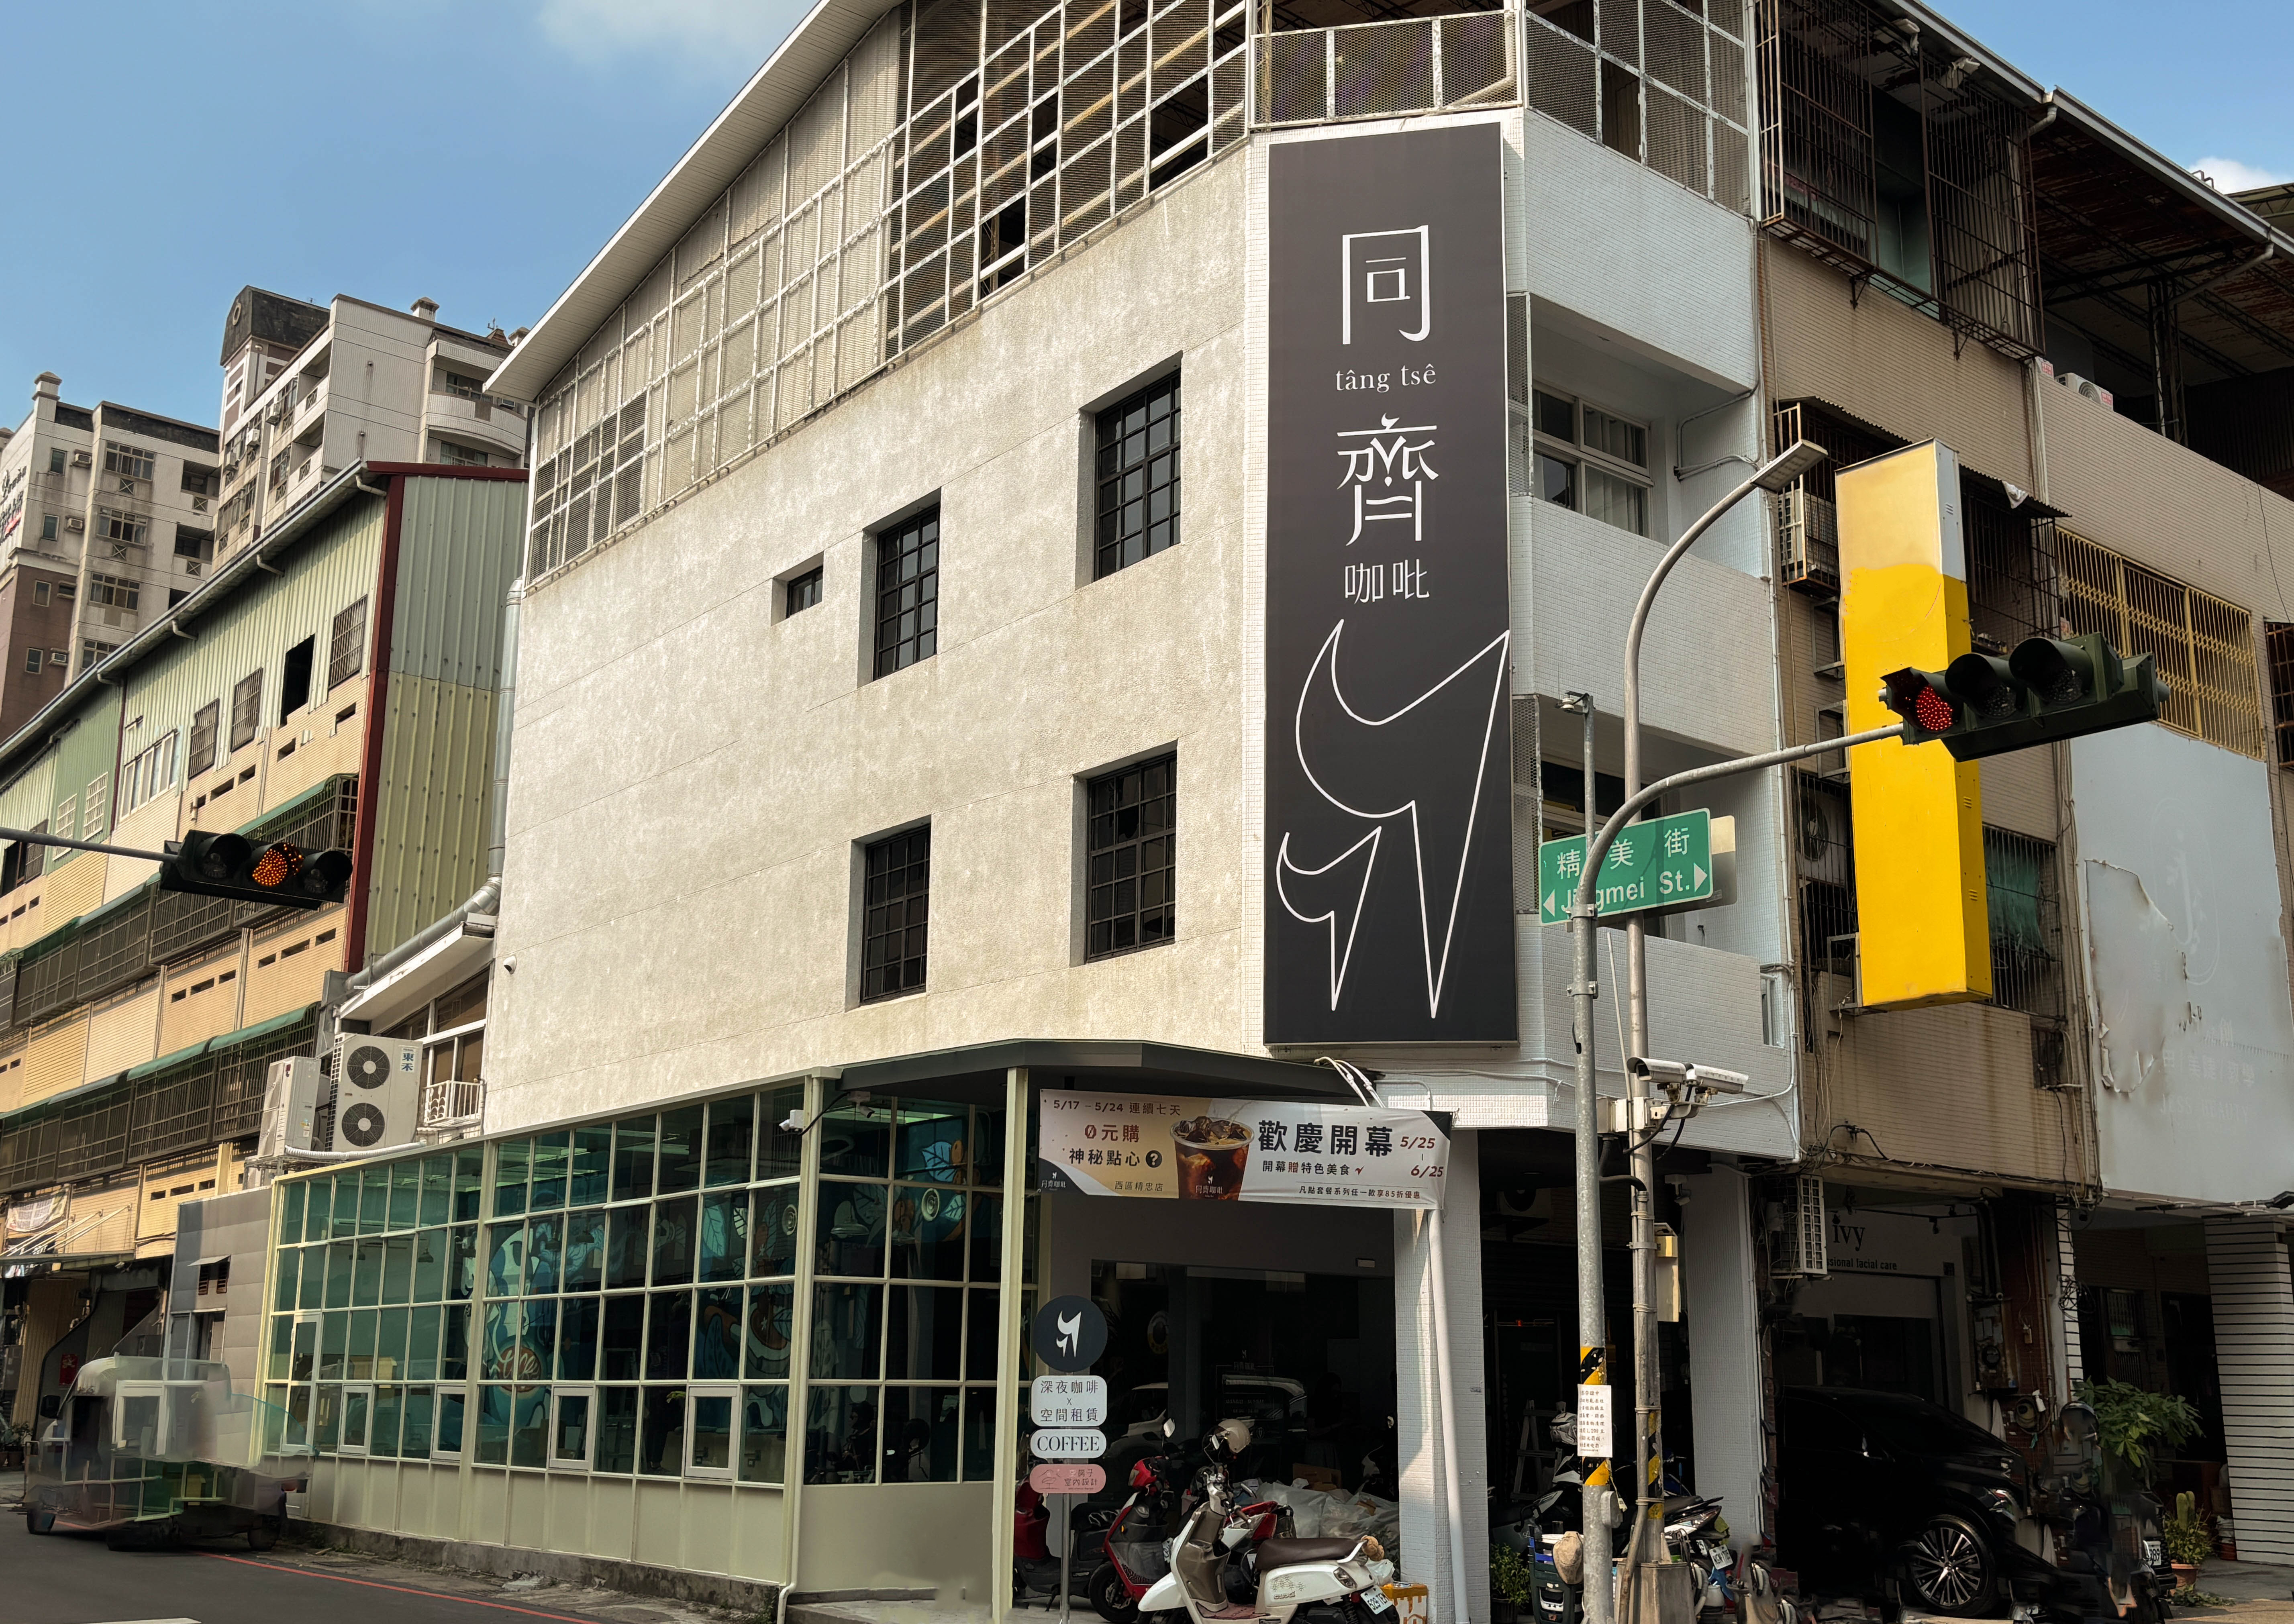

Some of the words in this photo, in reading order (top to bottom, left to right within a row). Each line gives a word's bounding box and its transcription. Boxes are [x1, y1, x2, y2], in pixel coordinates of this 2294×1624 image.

[1335, 368, 1391, 393] tâng
[1401, 363, 1436, 386] tsê
[1557, 827, 1690, 879] 精美街
[1561, 876, 1645, 913] Jigmei
[1659, 870, 1690, 894] St.
[1054, 1100, 1080, 1110] 5/17
[1095, 1102, 1124, 1112] 5/24
[1129, 1102, 1181, 1116] 連續七天
[1258, 1120, 1392, 1157] 歡慶開幕
[1400, 1136, 1436, 1149] 5/25
[1263, 1160, 1350, 1175] 開幕贈特色美食
[1411, 1165, 1444, 1178] 6/25
[1114, 1181, 1163, 1191] 西區精忠店
[1827, 1257, 1853, 1267] ssional
[1880, 1262, 1897, 1270] care
[1041, 1380, 1099, 1394] 深夜咖啡
[1041, 1408, 1098, 1422] 空間租賃
[1037, 1436, 1100, 1451] COFFEE
